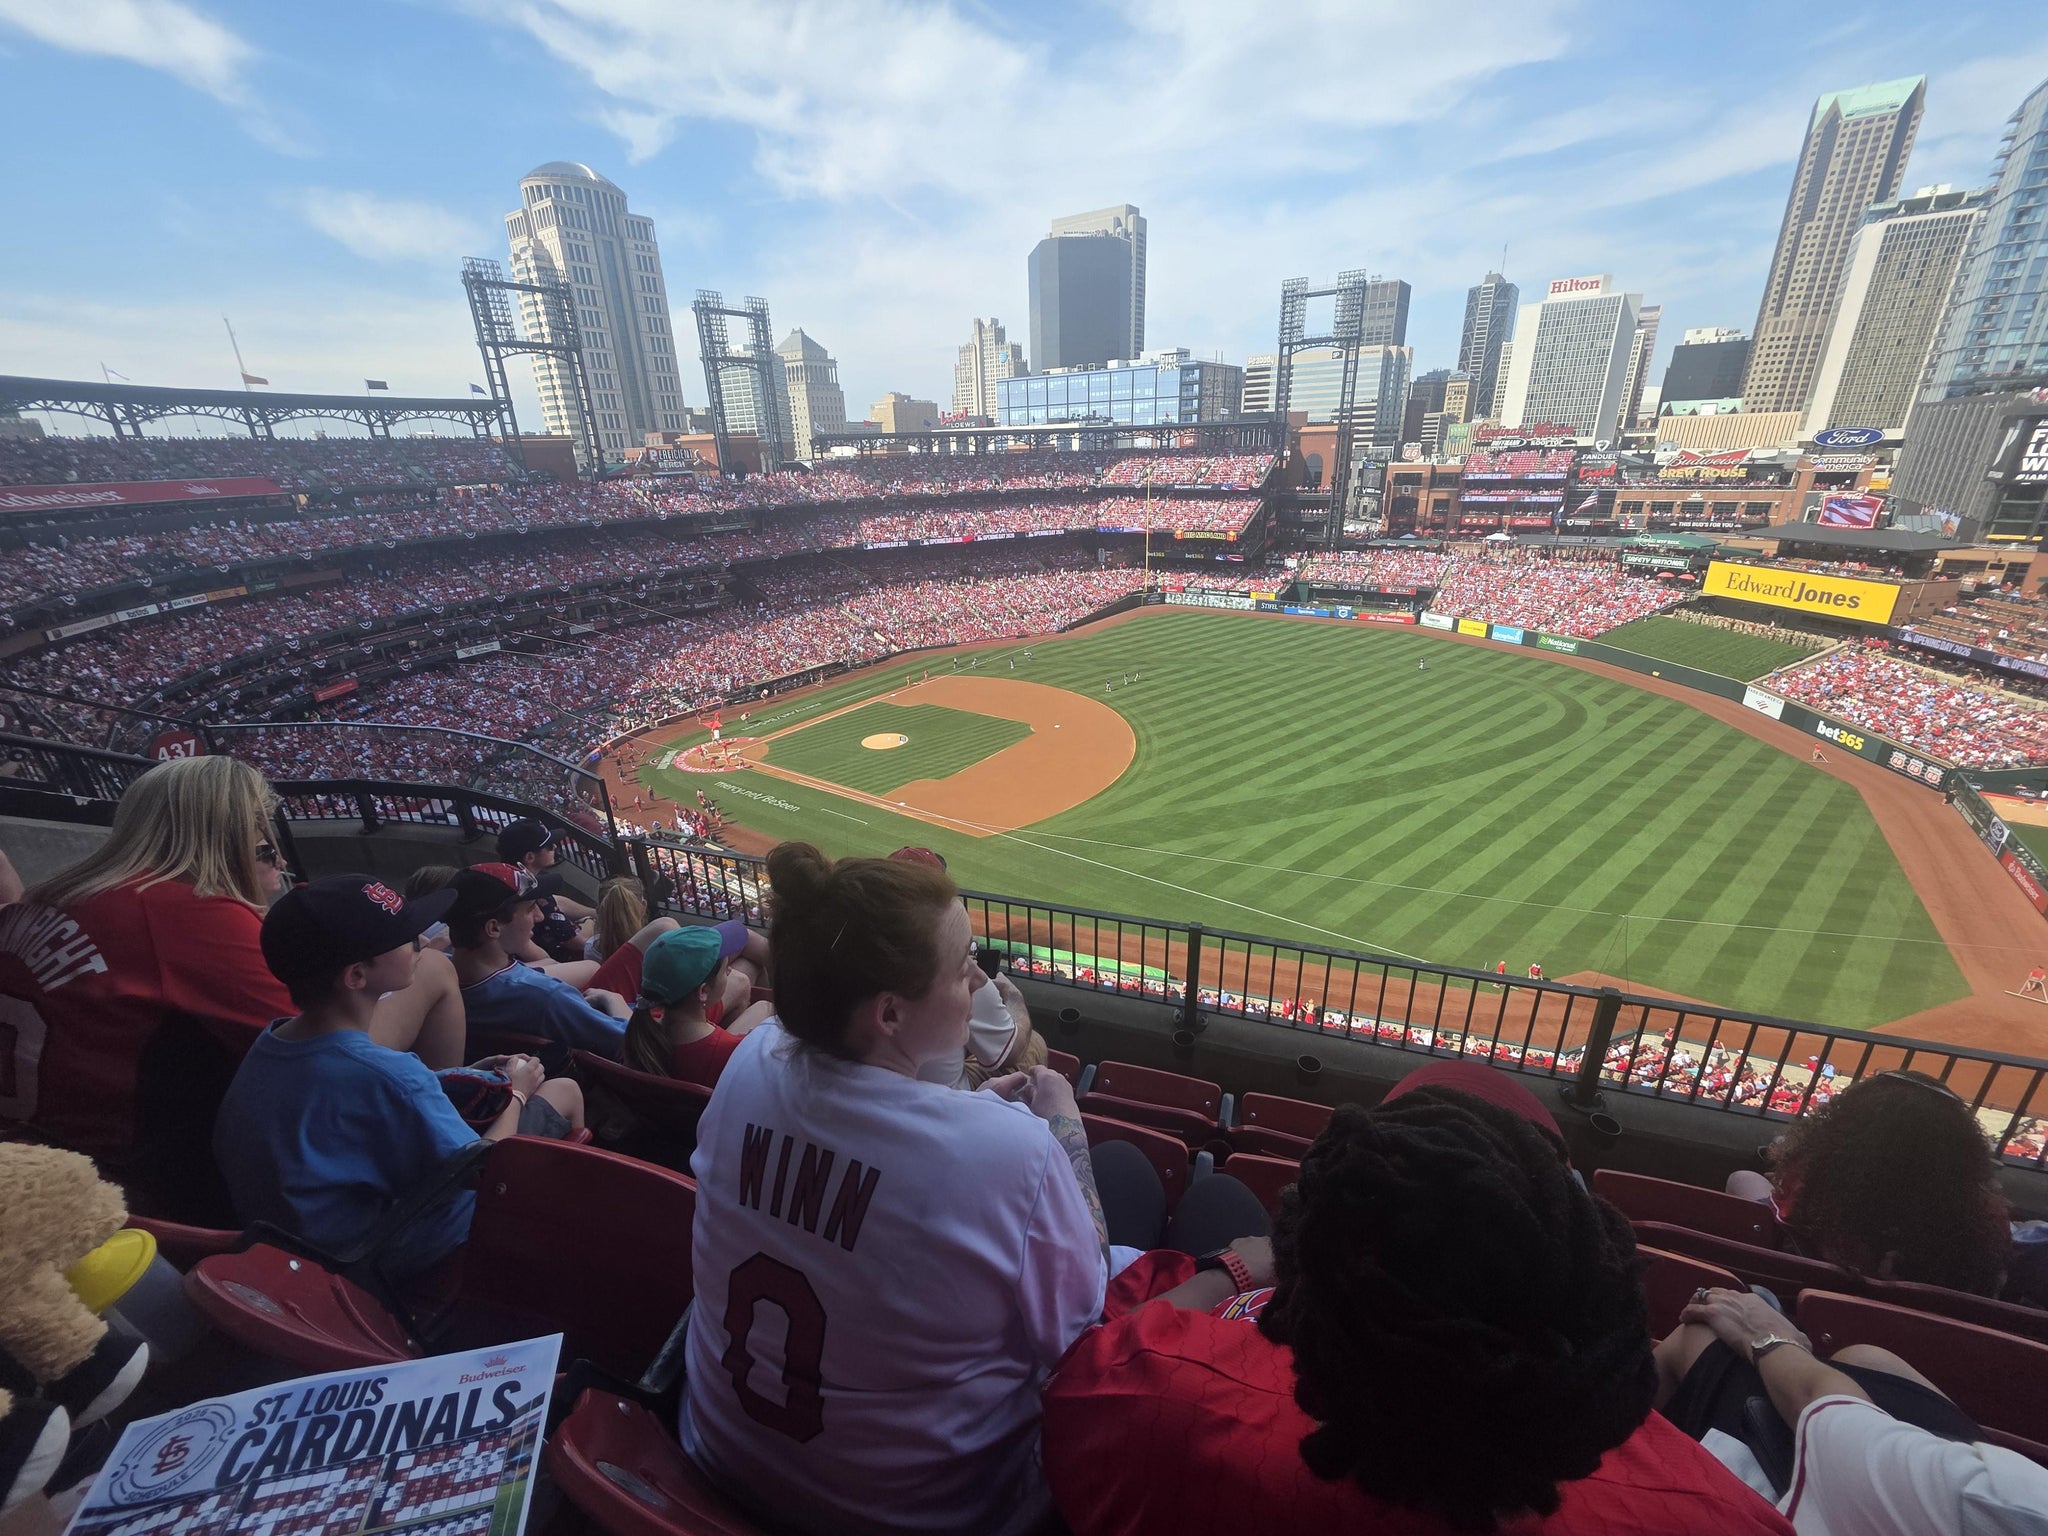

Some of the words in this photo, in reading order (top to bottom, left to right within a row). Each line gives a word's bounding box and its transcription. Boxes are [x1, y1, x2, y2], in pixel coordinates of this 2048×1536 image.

[1551, 279, 1600, 294] Hilton
[1159, 362, 1179, 374] pwc
[940, 407, 968, 425] Live!
[1475, 423, 1528, 440] Cardinals
[1827, 430, 1870, 444] Ford
[2030, 428, 2048, 443] F
[1404, 449, 1418, 457] 66
[1810, 455, 1875, 465] Community
[1579, 463, 1617, 479] Live!
[1657, 468, 1697, 478] BREW
[1699, 467, 1748, 478] HOUSE
[1626, 556, 1650, 564] SAFETY
[1651, 557, 1685, 567] NATIONAL
[1725, 571, 1795, 599] Edward
[1793, 582, 1860, 609] Jones
[1261, 602, 1278, 610] STIFEL
[1547, 637, 1577, 650] National
[1913, 634, 1941, 649] OPENING
[1941, 640, 1954, 652] DAY
[1953, 642, 1972, 657] 2026
[1747, 686, 1758, 694] BANK
[1764, 692, 1783, 705] AMERICA
[1816, 720, 1865, 751] bet365
[158, 739, 196, 761] 437
[739, 1123, 881, 1252] WINN
[721, 1251, 828, 1444] 0
[458, 1364, 527, 1385] Budweiser
[244, 1392, 295, 1430] ST.
[294, 1376, 388, 1419] LOUIS
[174, 1408, 210, 1426] 2026
[214, 1379, 522, 1489] CARDINALS
[124, 1472, 190, 1501] SCHEDULE
